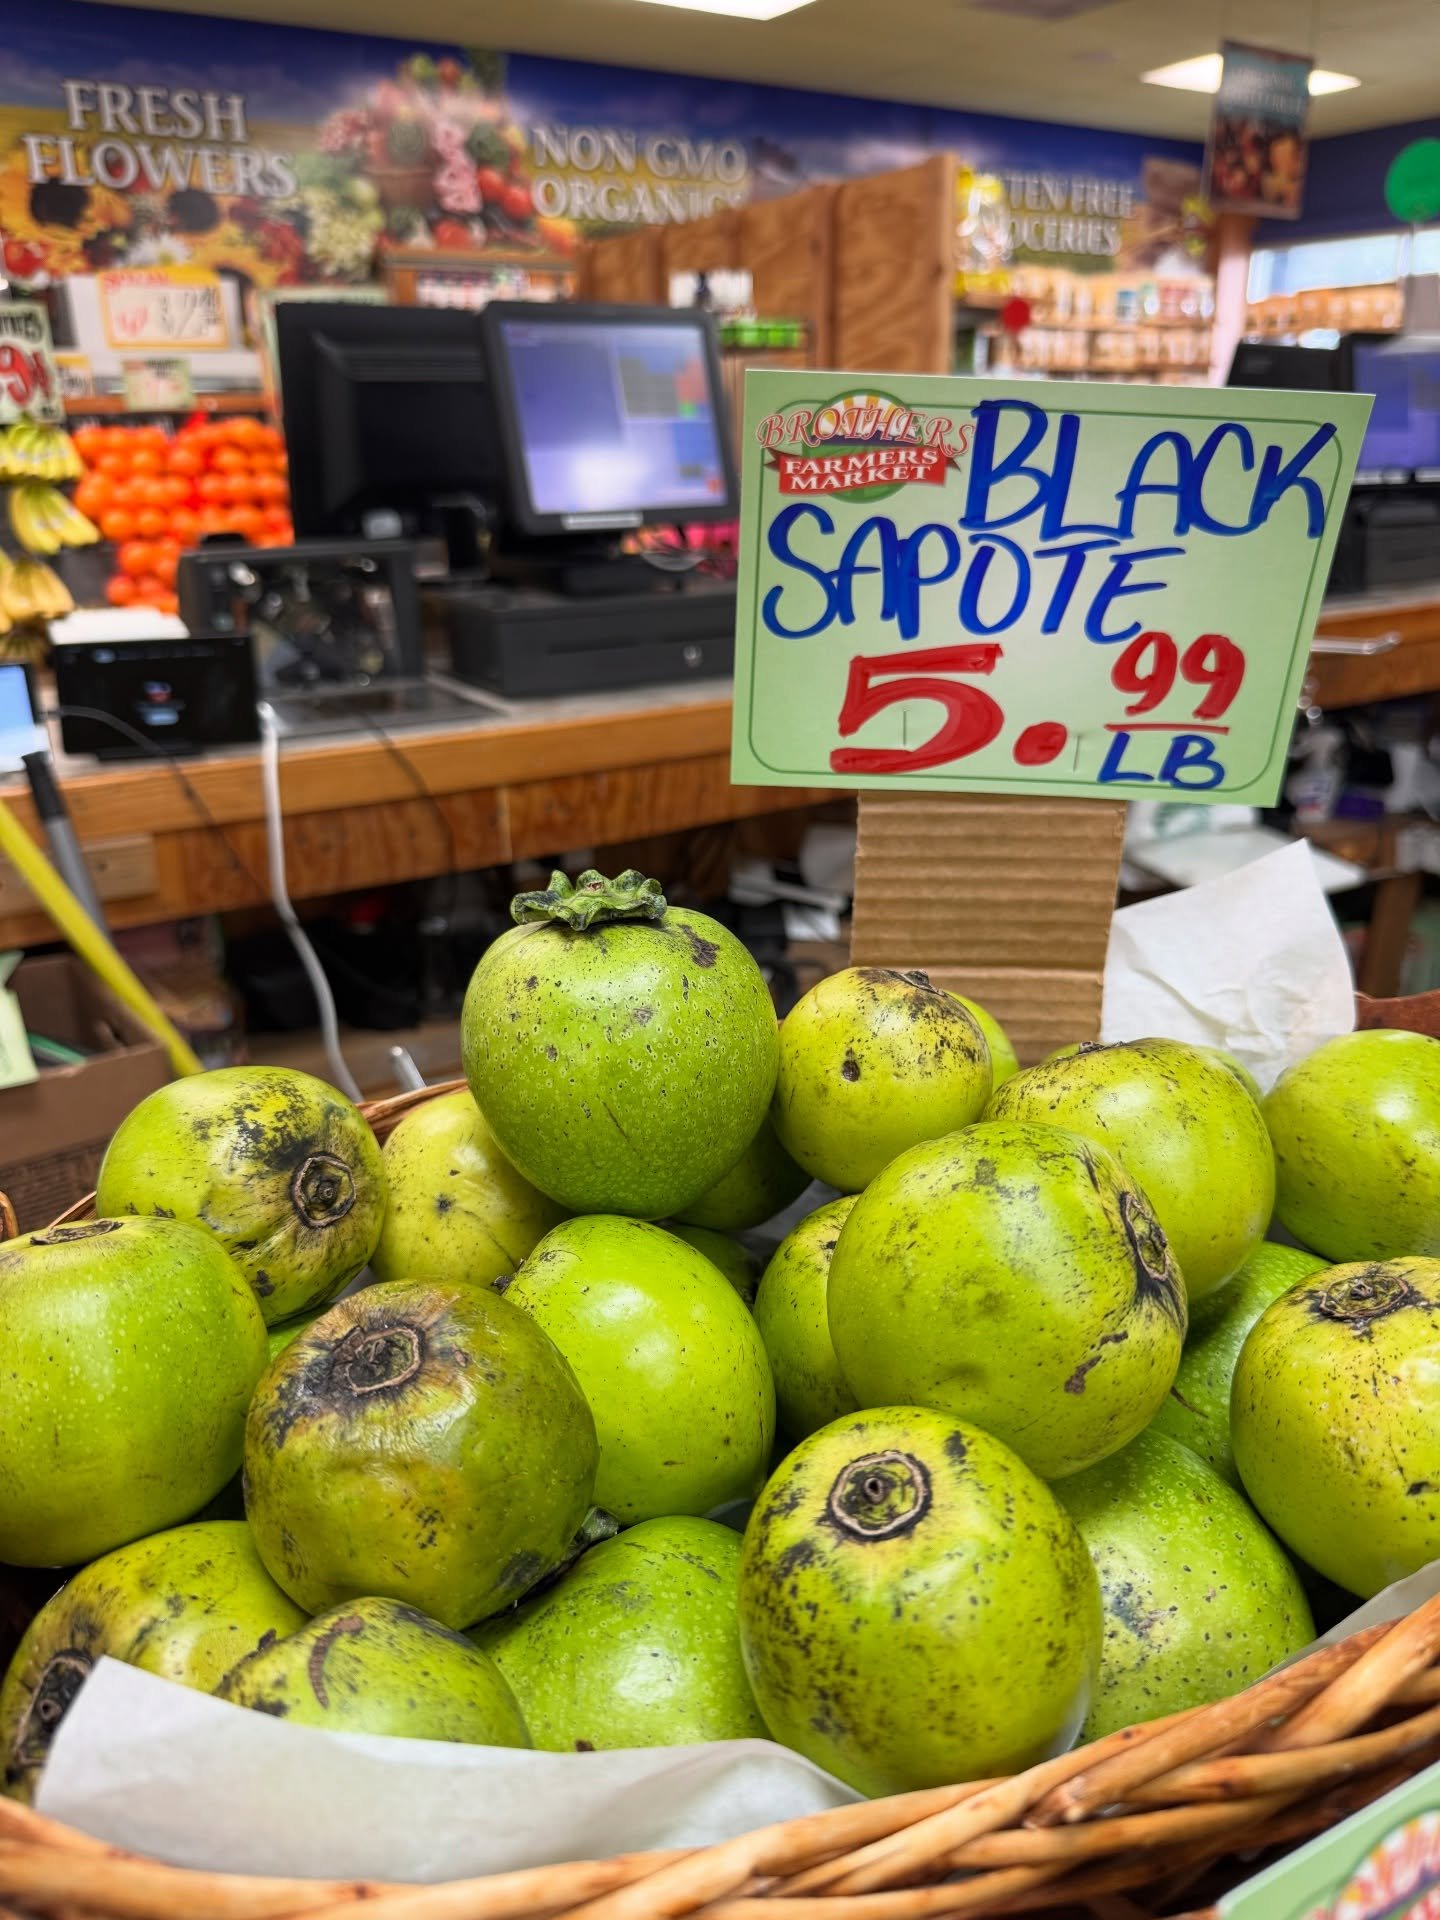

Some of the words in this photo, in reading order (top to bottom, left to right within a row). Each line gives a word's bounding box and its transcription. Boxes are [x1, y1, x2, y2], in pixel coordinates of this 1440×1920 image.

[63, 79, 249, 142] FRESH
[22, 133, 297, 198] FLOWERS
[531, 126, 639, 173] NON
[645, 136, 748, 184] GMO
[1071, 178, 1134, 219] FREE
[757, 406, 976, 457] BROTHERS
[785, 449, 938, 474] FARMERS
[790, 465, 931, 490] MARKET
[959, 400, 1337, 542] BLACK
[762, 503, 1186, 644] SAPOTE
[1097, 732, 1225, 789] LB
